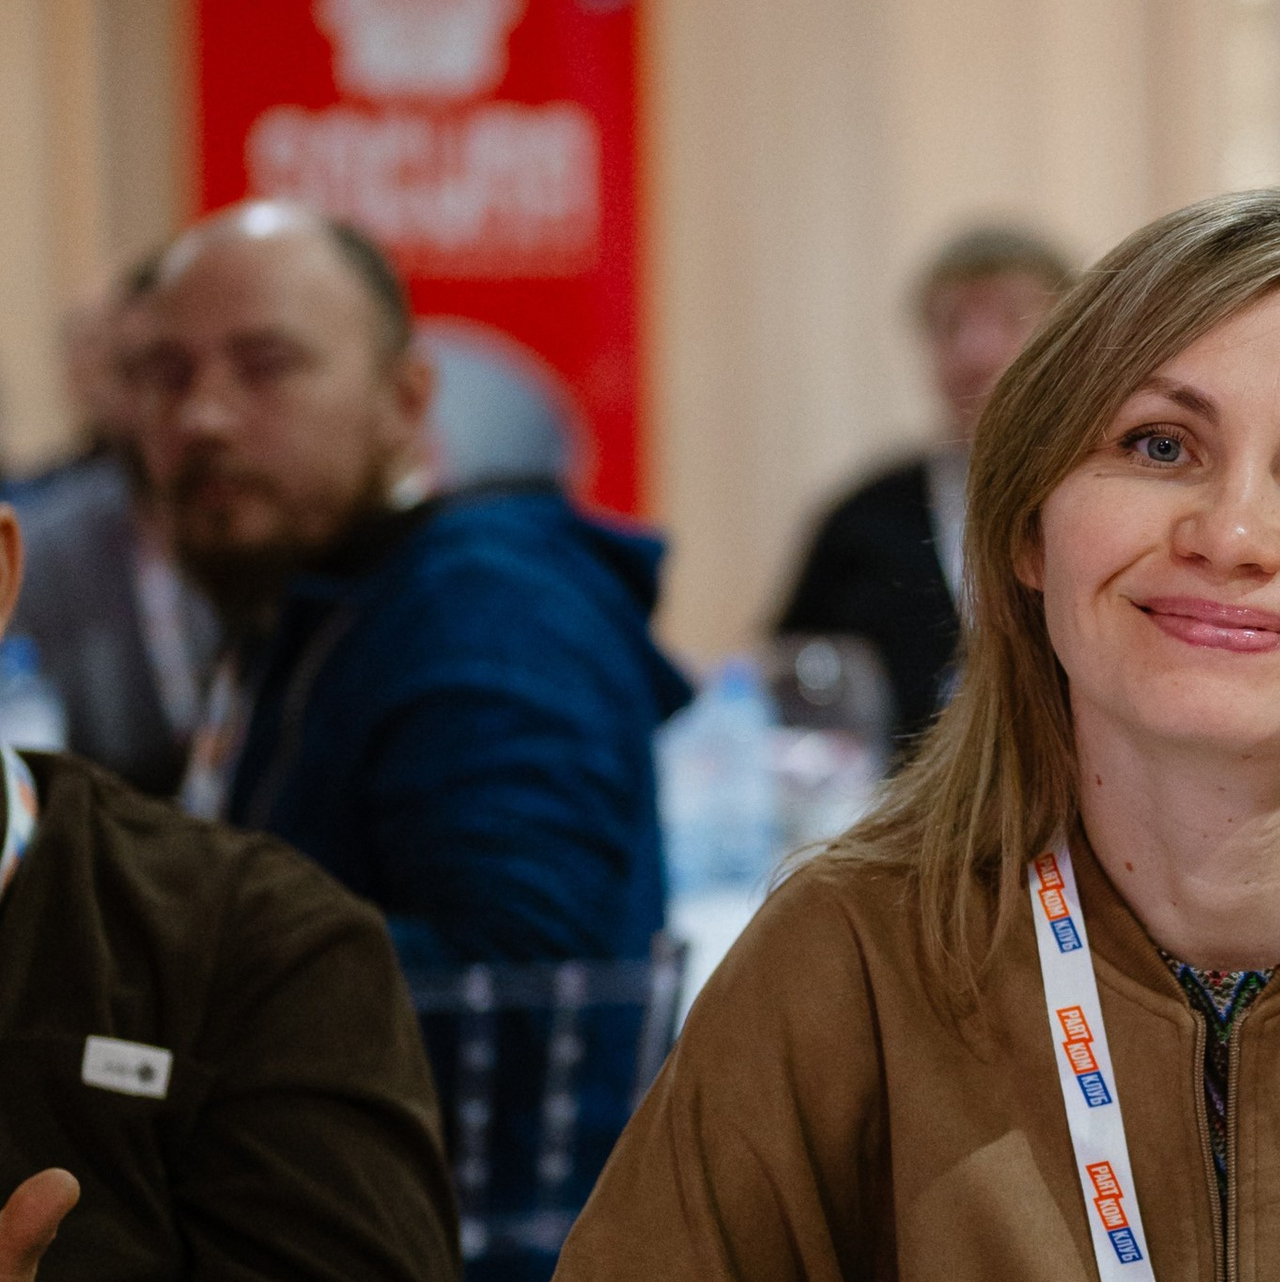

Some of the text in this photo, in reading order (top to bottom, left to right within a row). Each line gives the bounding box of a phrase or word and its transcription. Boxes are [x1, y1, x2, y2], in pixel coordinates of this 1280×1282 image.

[1042, 889, 1067, 917] KOM
[1054, 918, 1078, 952] КЛУБ
[1061, 1008, 1108, 1107] PART KOM КЛУБ
[1091, 1164, 1137, 1262] PART KOM КЛУБ
